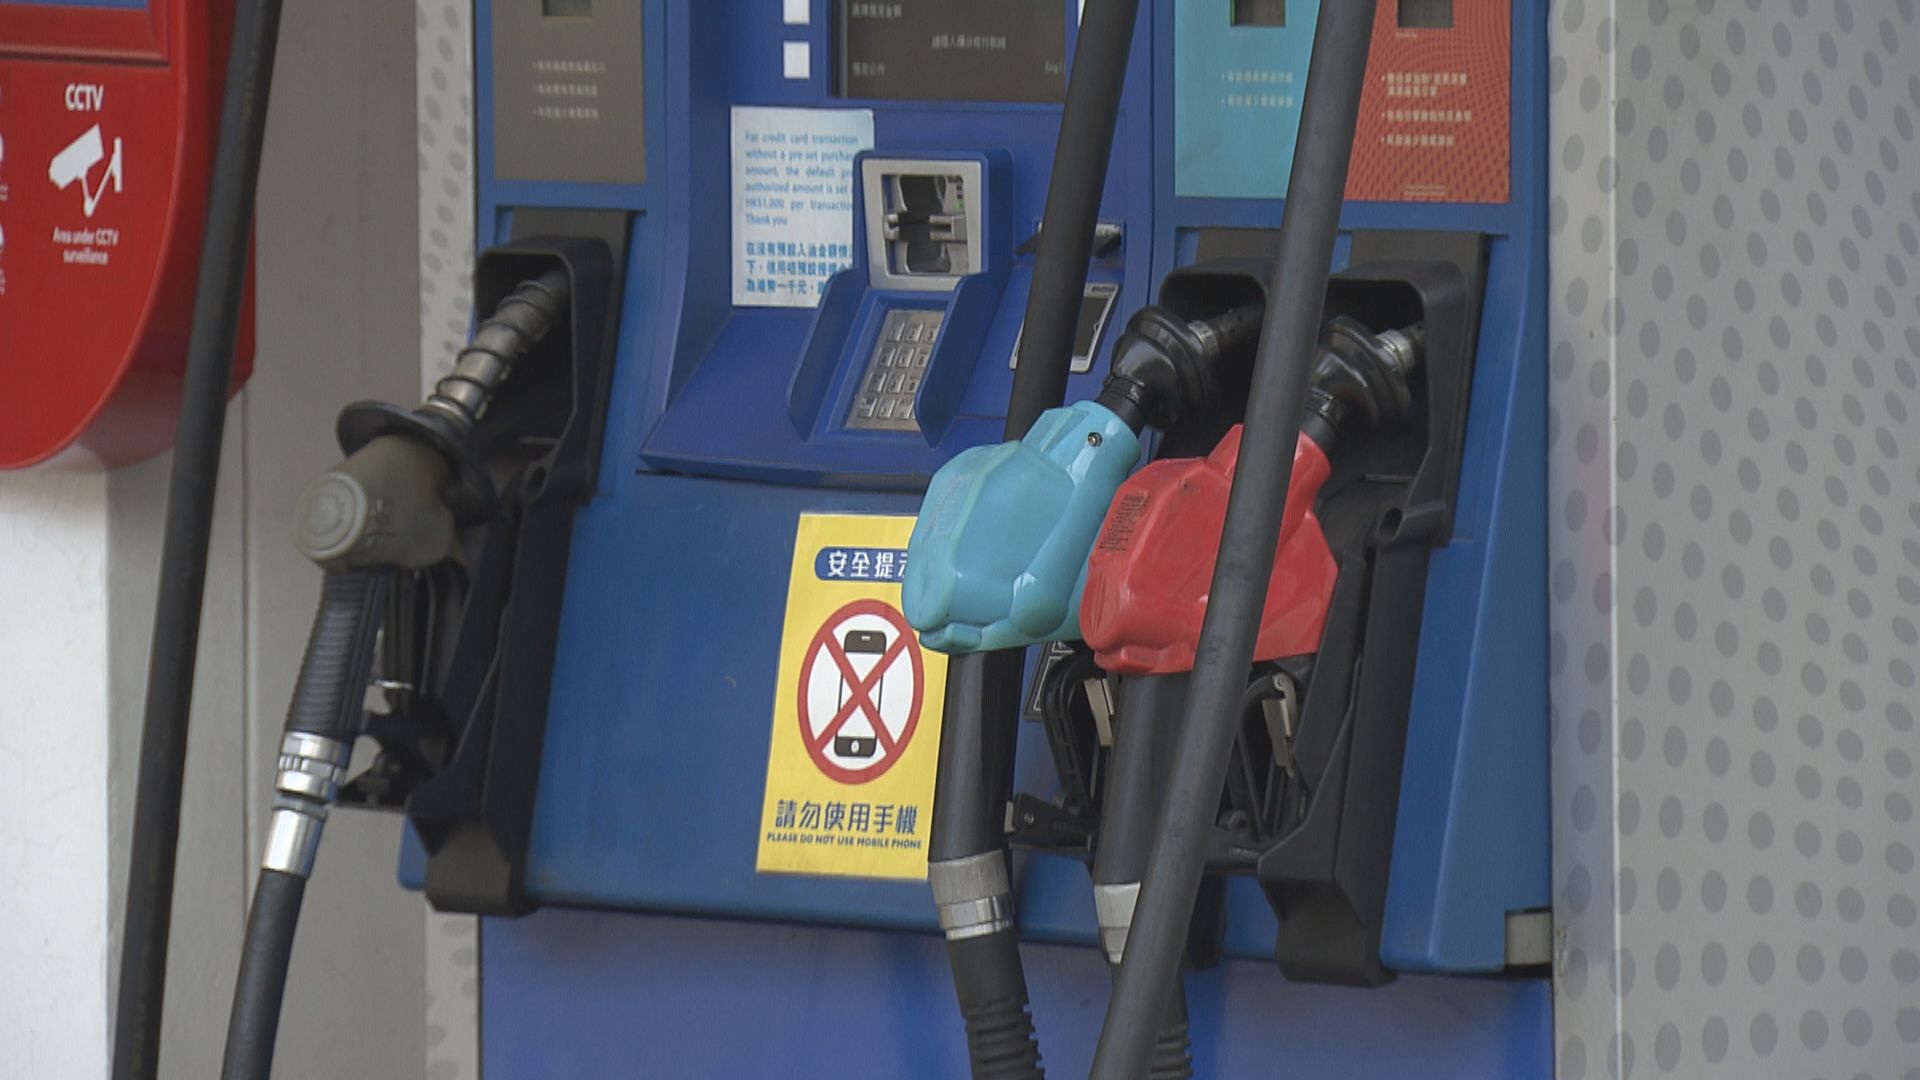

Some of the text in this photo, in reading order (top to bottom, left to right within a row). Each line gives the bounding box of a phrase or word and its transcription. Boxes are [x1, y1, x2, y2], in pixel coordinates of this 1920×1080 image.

[65, 83, 104, 111] CCTV
[745, 131, 858, 144] For credit card transaction
[745, 149, 777, 160] without
[786, 166, 799, 177] the
[806, 166, 835, 177] default
[745, 182, 848, 194] authorized amount is set
[791, 200, 805, 213] per
[745, 214, 788, 228] Thank you
[53, 227, 119, 246] Area under CCTV
[63, 248, 109, 265] surveillance
[775, 799, 918, 835] 請勿使用手機
[766, 832, 922, 850] PLEASE DO NOT USE MOBILE PHONE
